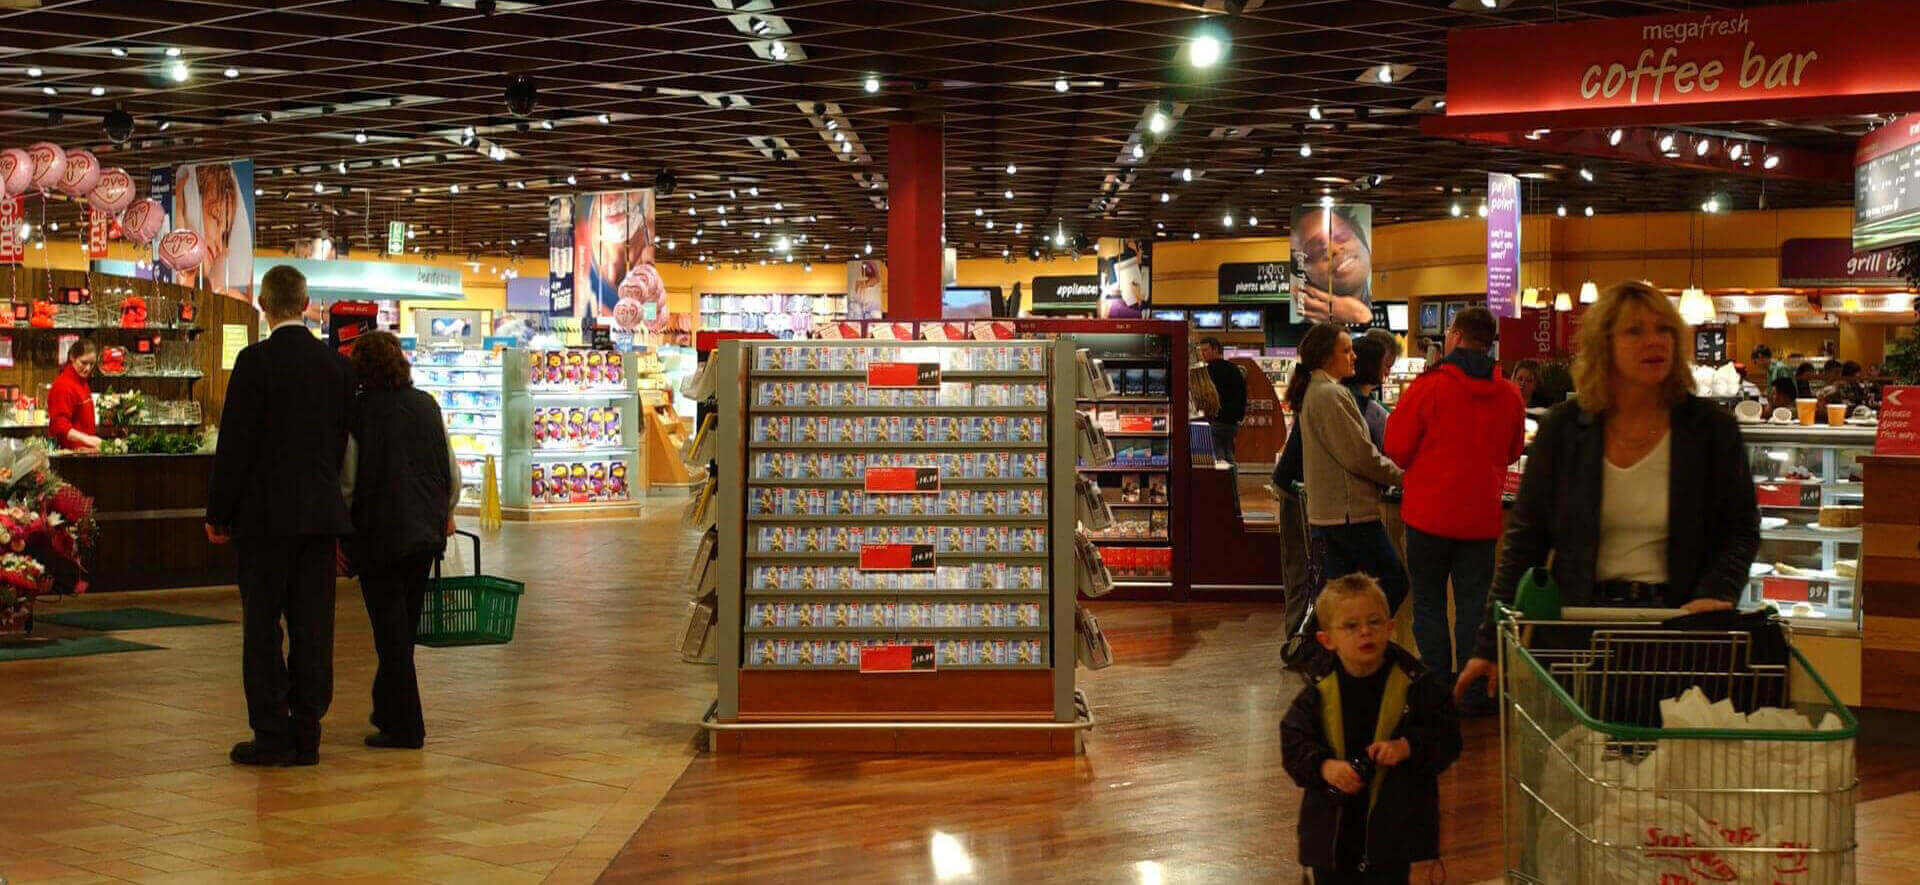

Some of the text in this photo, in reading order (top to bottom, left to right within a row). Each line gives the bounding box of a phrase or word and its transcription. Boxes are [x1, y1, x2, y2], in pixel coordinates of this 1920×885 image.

[1643, 13, 1749, 43] megafresh
[1580, 41, 1817, 103] coffee bar
[1491, 182, 1506, 197] pay
[1491, 199, 1513, 213] point
[1847, 253, 1881, 275] grill
